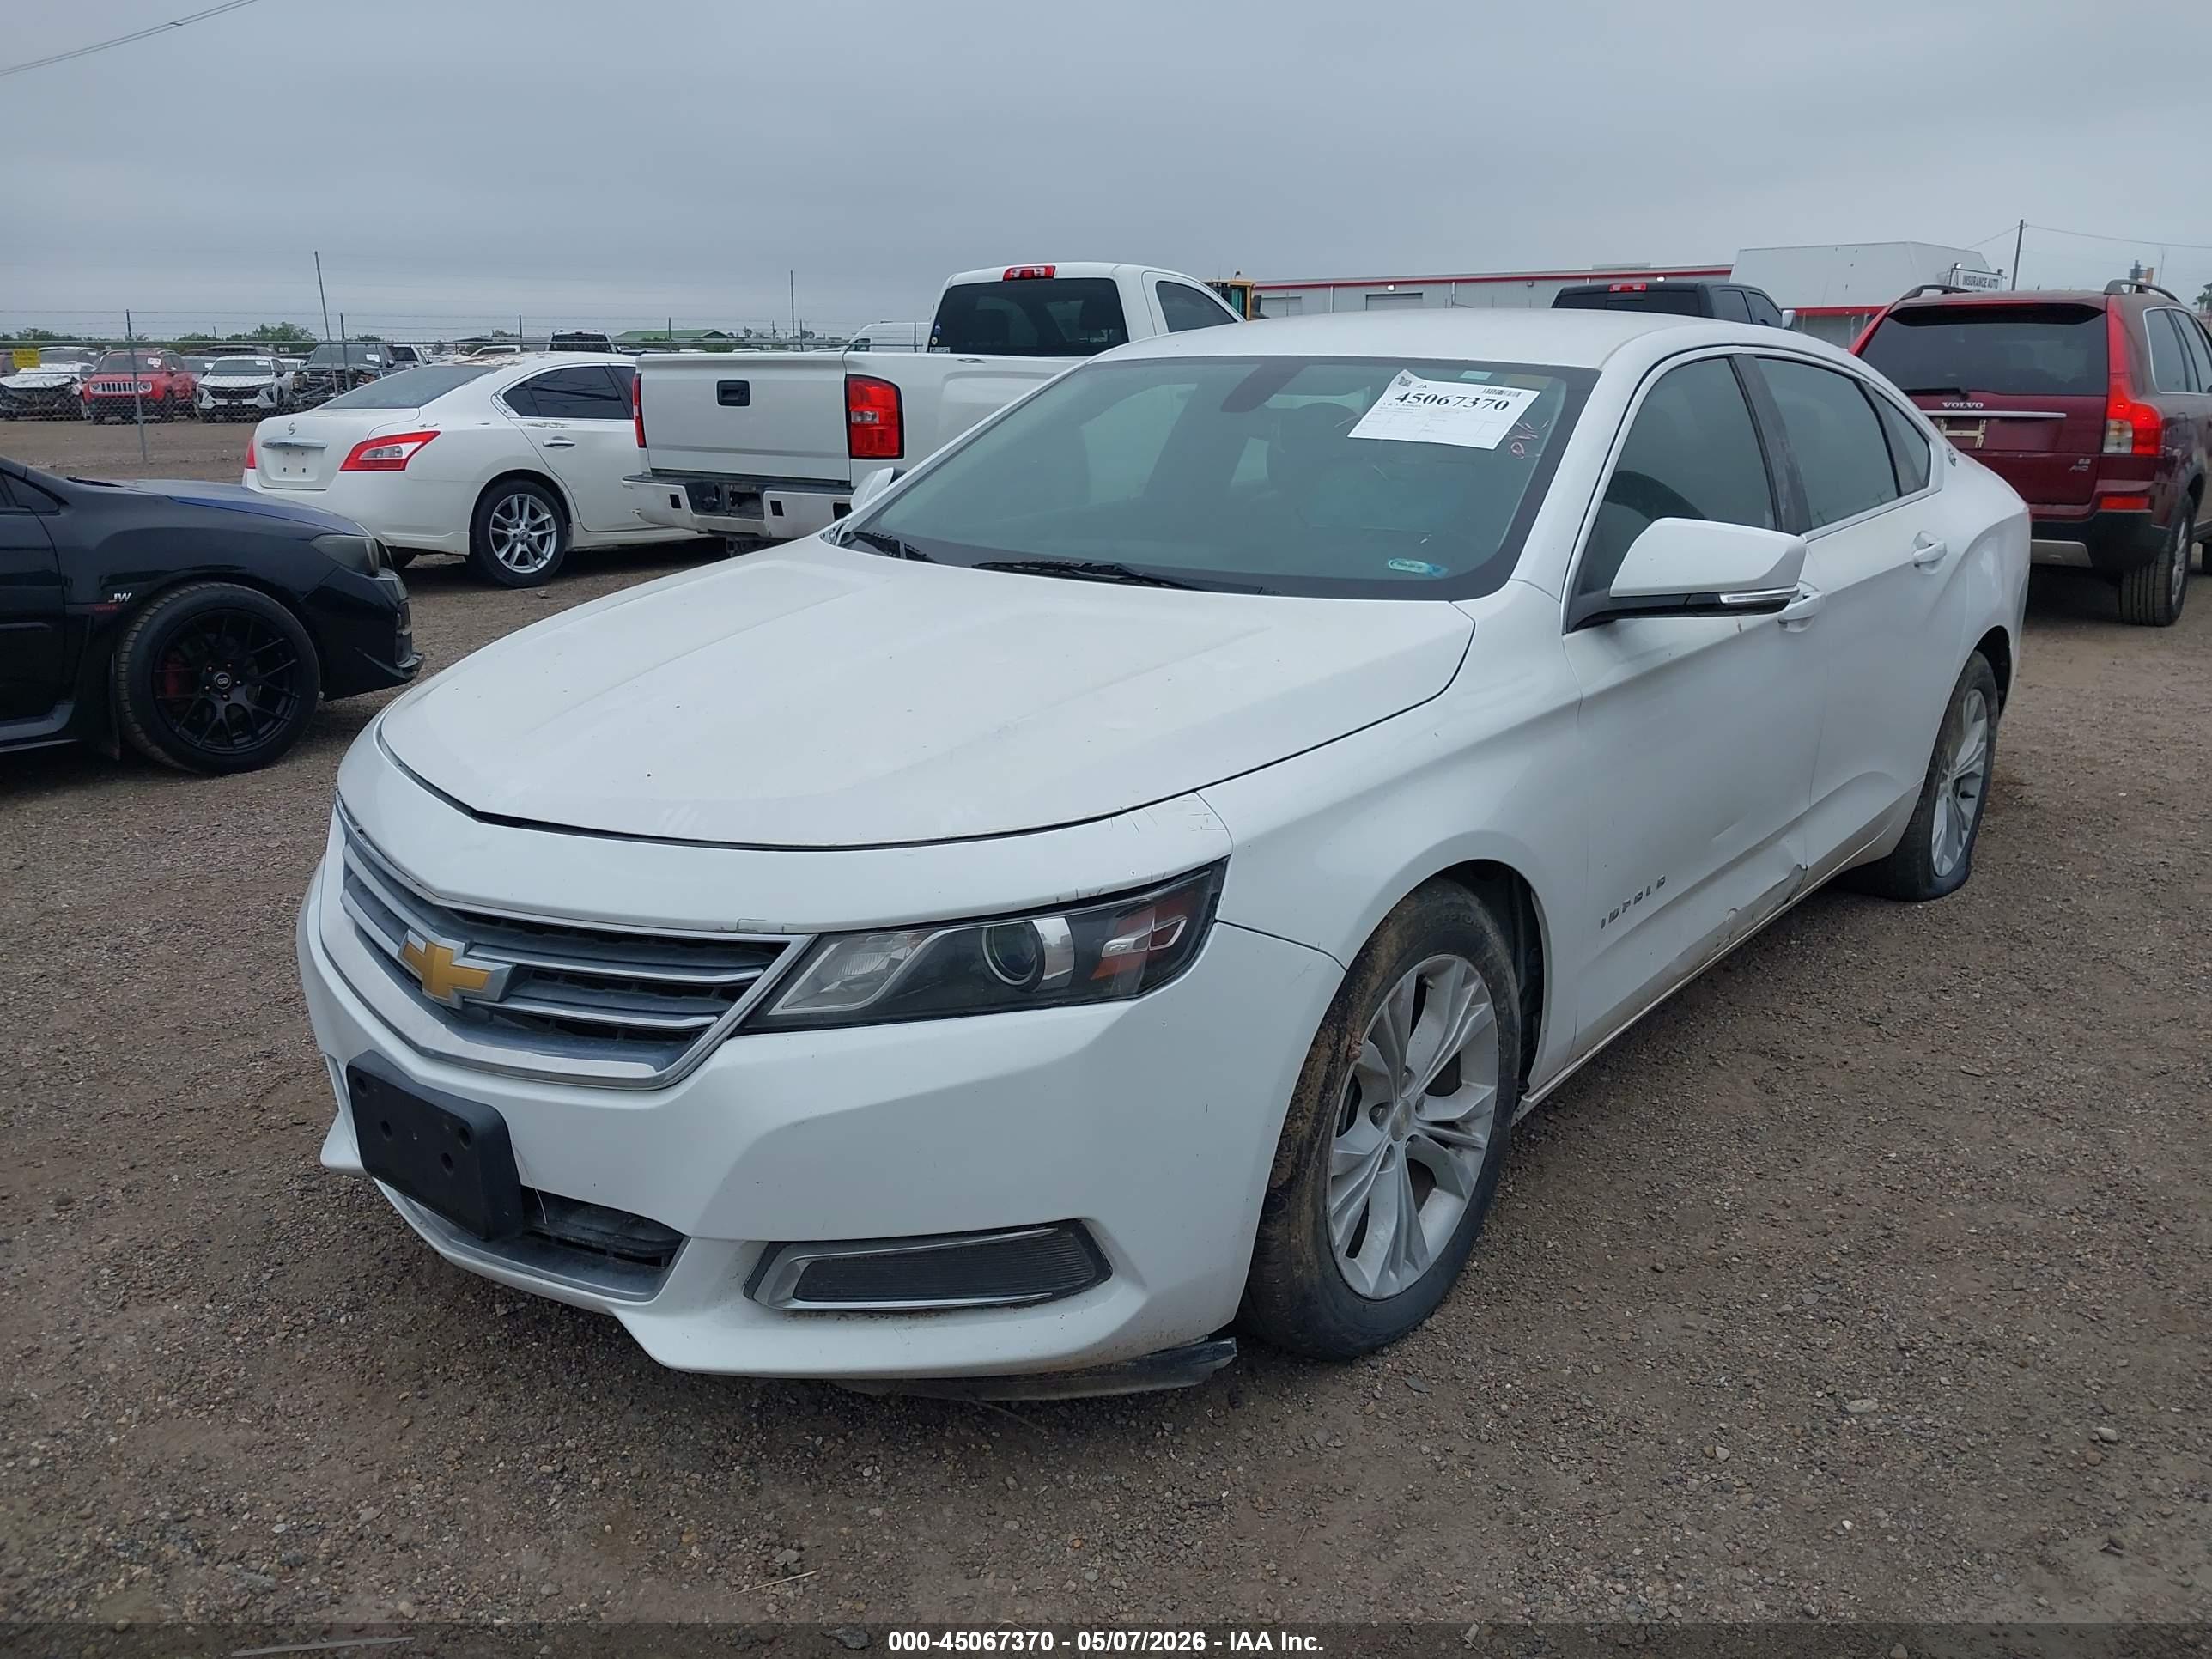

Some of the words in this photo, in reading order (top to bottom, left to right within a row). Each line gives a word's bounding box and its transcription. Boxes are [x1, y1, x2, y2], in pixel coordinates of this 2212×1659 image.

[1962, 275, 1987, 288] INSURANCE
[1987, 277, 1999, 289] AUTO
[1395, 391, 1510, 412] 45067370
